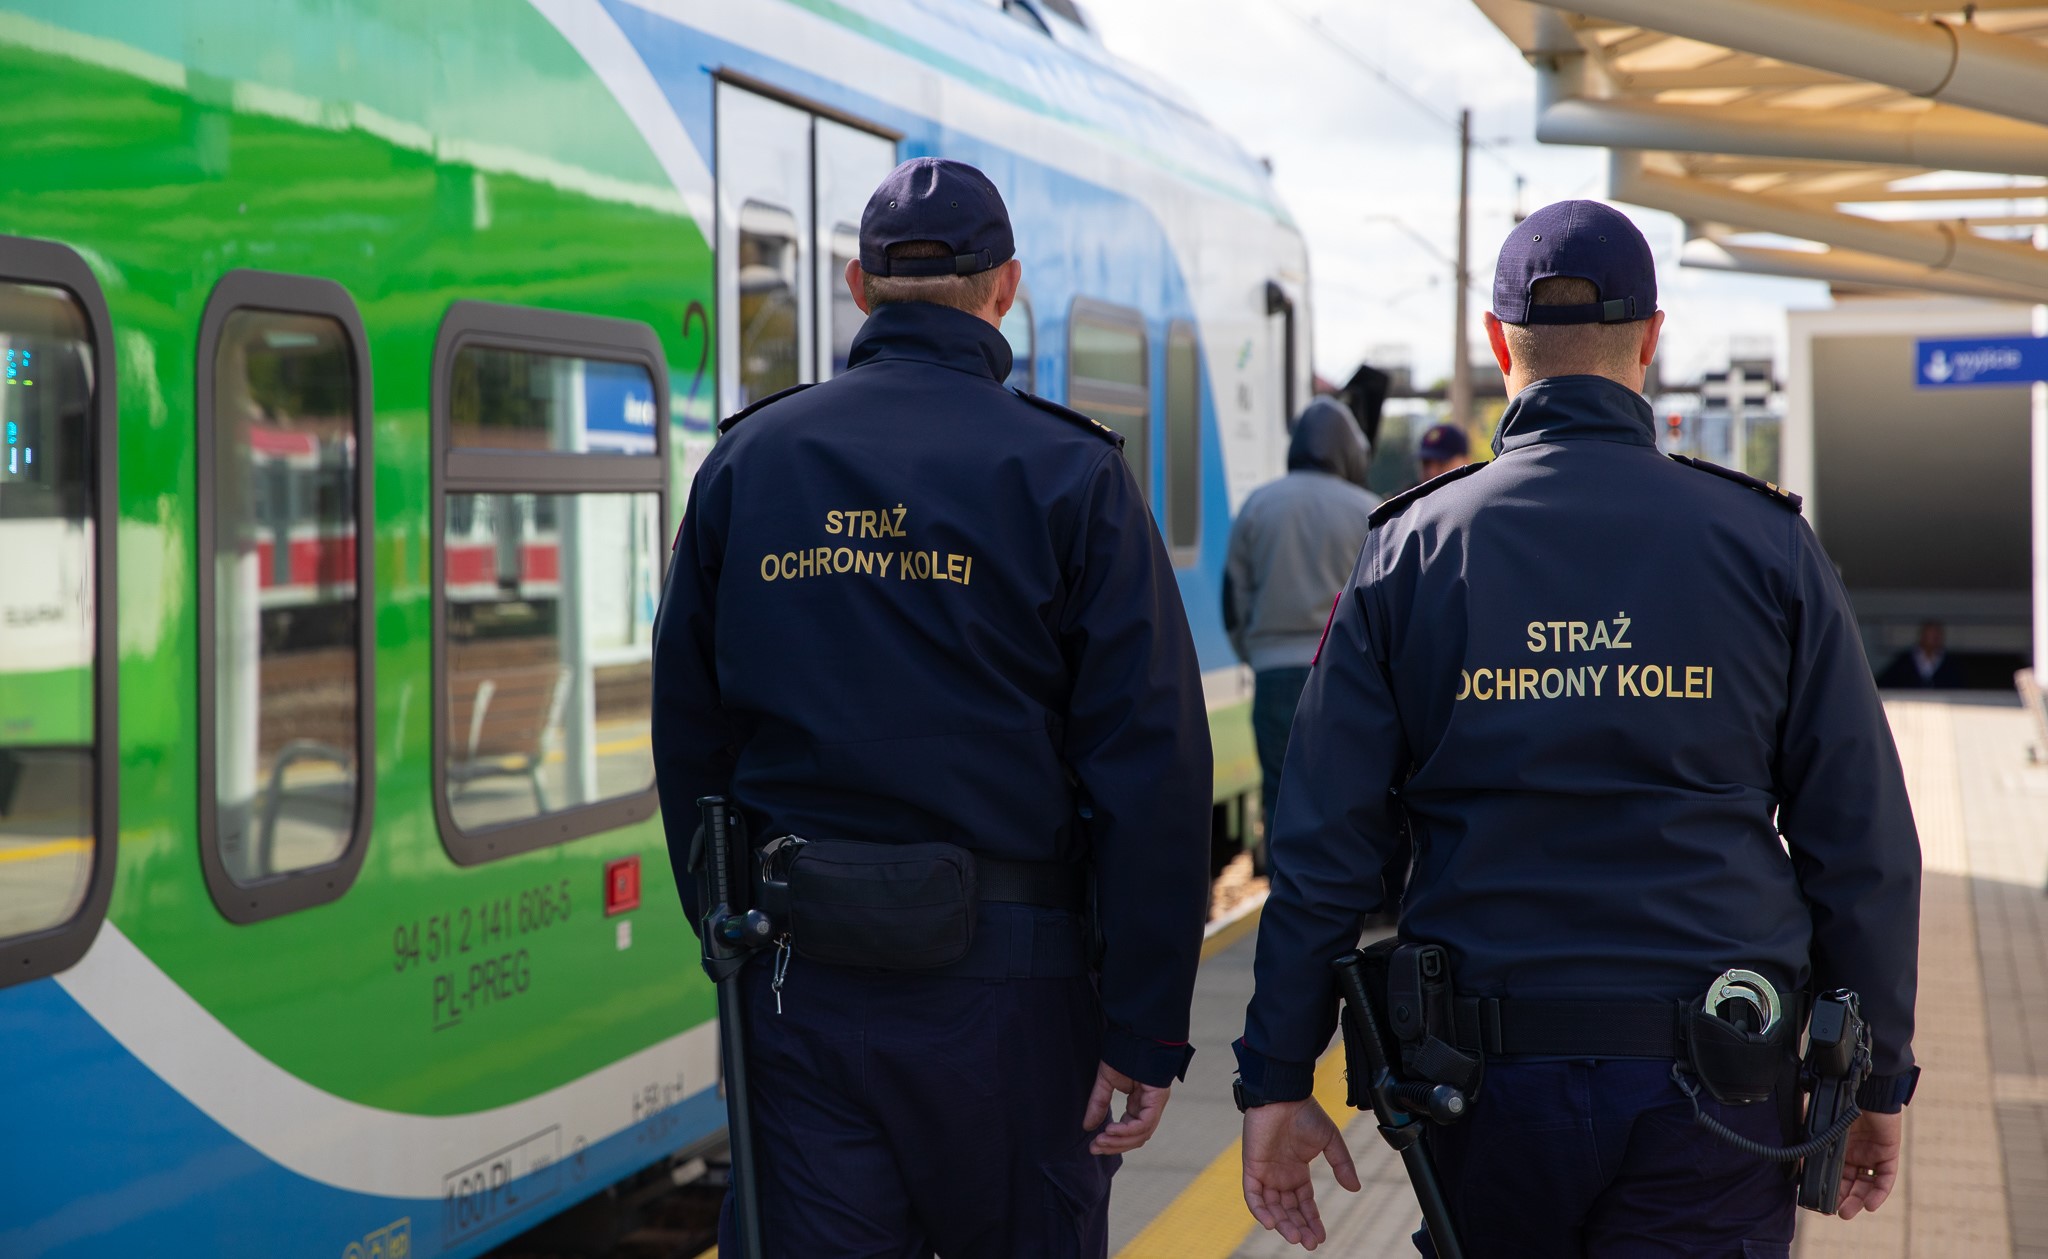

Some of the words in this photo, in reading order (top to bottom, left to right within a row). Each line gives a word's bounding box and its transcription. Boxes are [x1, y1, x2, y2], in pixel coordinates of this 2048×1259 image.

[825, 503, 907, 539] STRAŻ
[760, 547, 894, 582] OCHRONY
[900, 551, 973, 586] KOLEI
[1526, 611, 1632, 653] STRAŻ
[1618, 665, 1713, 699] KOLEI
[393, 921, 421, 973] 94
[426, 913, 451, 963] 51
[459, 907, 472, 953] 2
[479, 897, 512, 945] 141
[432, 948, 530, 1024] PL-PREG
